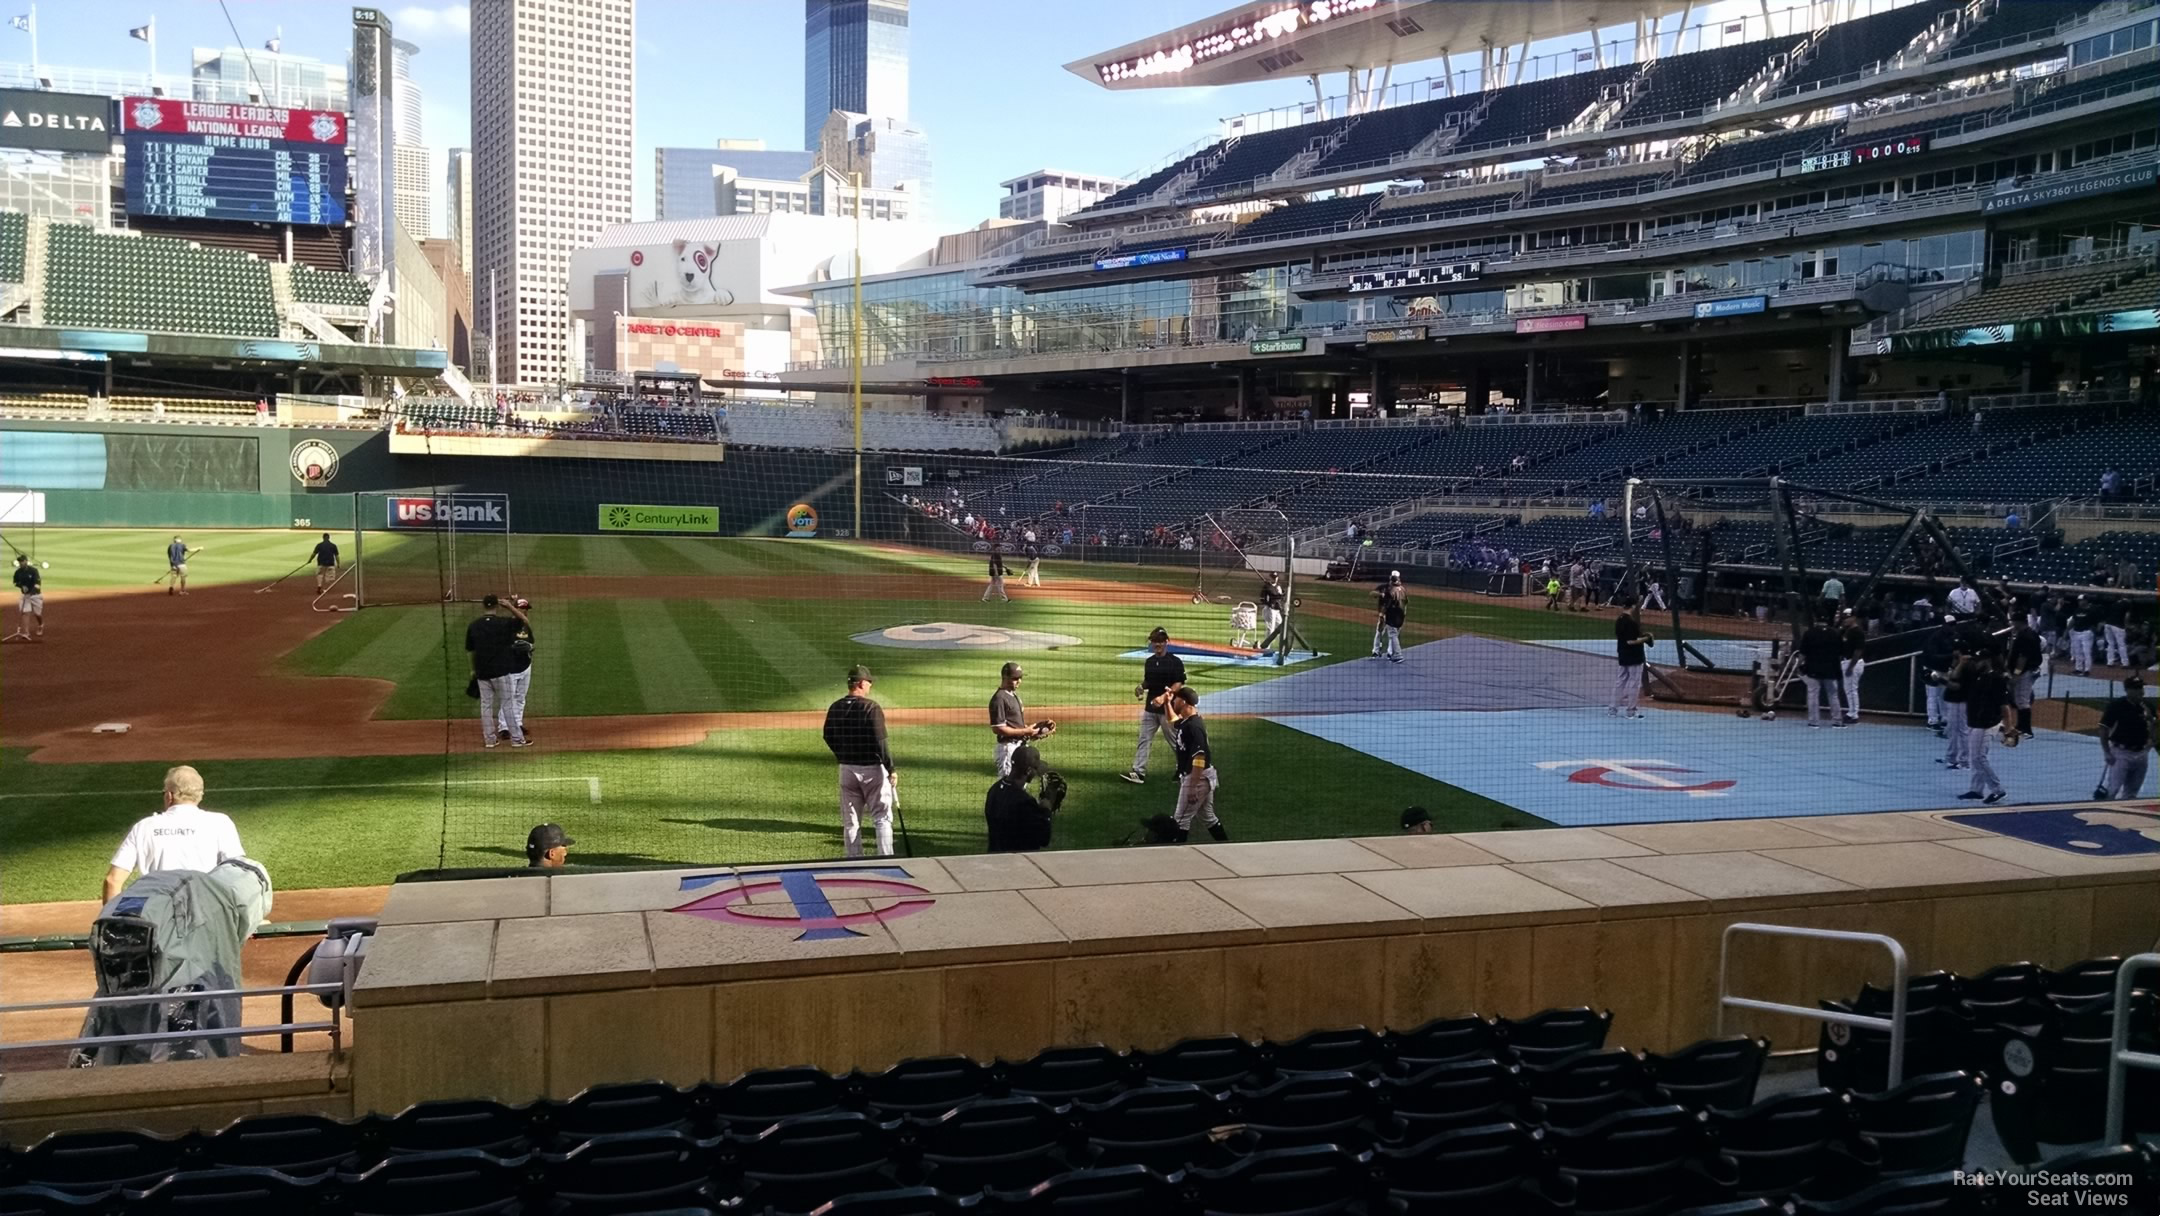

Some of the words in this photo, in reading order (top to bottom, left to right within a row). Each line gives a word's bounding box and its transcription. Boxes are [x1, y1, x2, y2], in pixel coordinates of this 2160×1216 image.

[183, 102, 232, 119] LEAGUE
[233, 105, 289, 123] LEADERS
[28, 112, 105, 131] DELTA
[187, 120, 242, 136] NATIONAL
[244, 123, 287, 139] LEAGUE
[204, 135, 236, 147] HOME
[239, 137, 270, 150] RUNS
[1871, 147, 1879, 158] 0
[1884, 145, 1892, 156] 0
[1897, 142, 1905, 153] 0
[175, 143, 215, 156] ARENADO
[275, 151, 292, 161] COL
[175, 154, 209, 165] BRYANT
[275, 161, 292, 171] CHC
[175, 164, 209, 176] CARTER
[276, 171, 292, 181] MIL
[175, 175, 208, 186] DUVALL
[276, 181, 292, 191] CIN
[1997, 194, 2030, 208] DELTA
[2074, 176, 2121, 193] LEGENDS
[2124, 171, 2153, 183] CLUB
[175, 185, 204, 196] BRUCE
[274, 191, 294, 202] NYM
[175, 195, 216, 208] FREEMAN
[276, 202, 292, 212] ATL
[175, 206, 206, 217] TOMAS
[277, 212, 292, 222] ARI
[676, 326, 721, 338] CENTER
[722, 368, 750, 378] Great
[294, 518, 311, 528] 365
[635, 512, 709, 527] CenturyLink
[791, 517, 816, 526] VOTE
[153, 828, 196, 836] SECURITY
